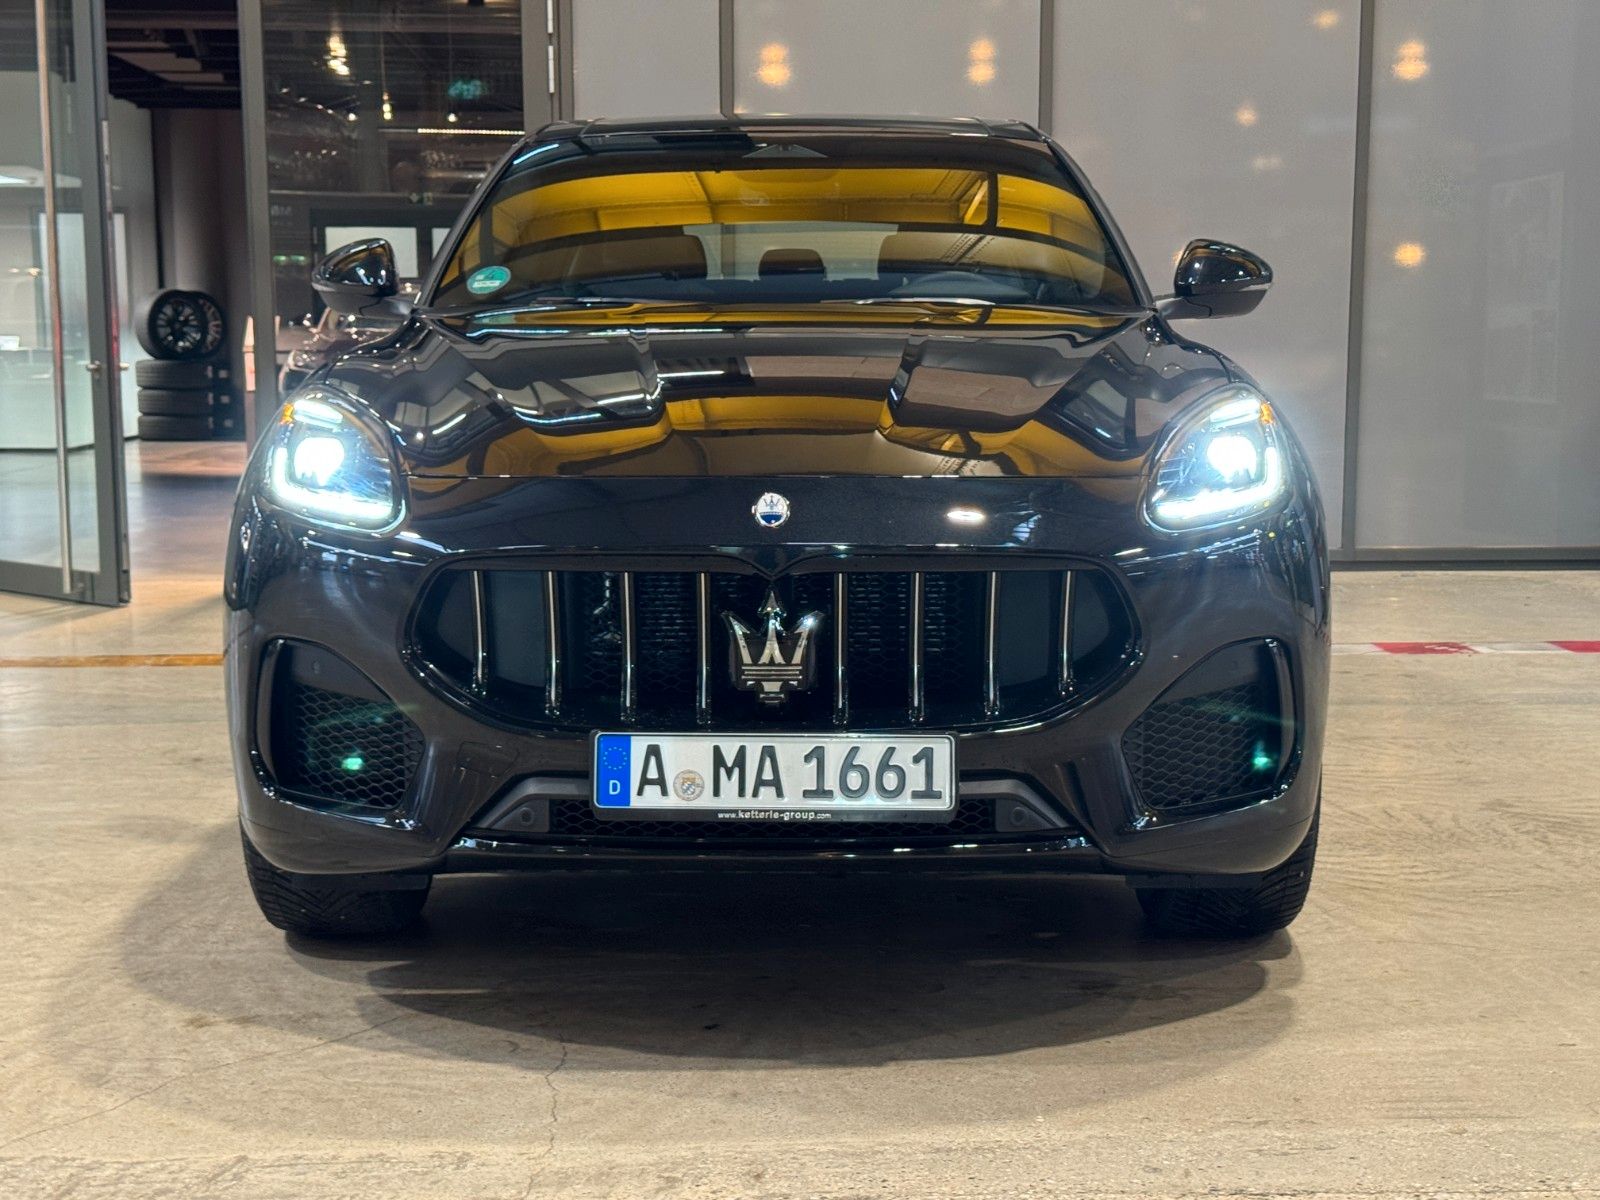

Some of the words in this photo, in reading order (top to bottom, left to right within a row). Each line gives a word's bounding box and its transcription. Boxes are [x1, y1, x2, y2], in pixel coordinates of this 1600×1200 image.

[637, 744, 669, 797] A
[713, 745, 784, 798] MA
[803, 746, 942, 800] 1661
[609, 780, 621, 795] D
[717, 809, 832, 821] www.ketterle-group.com
